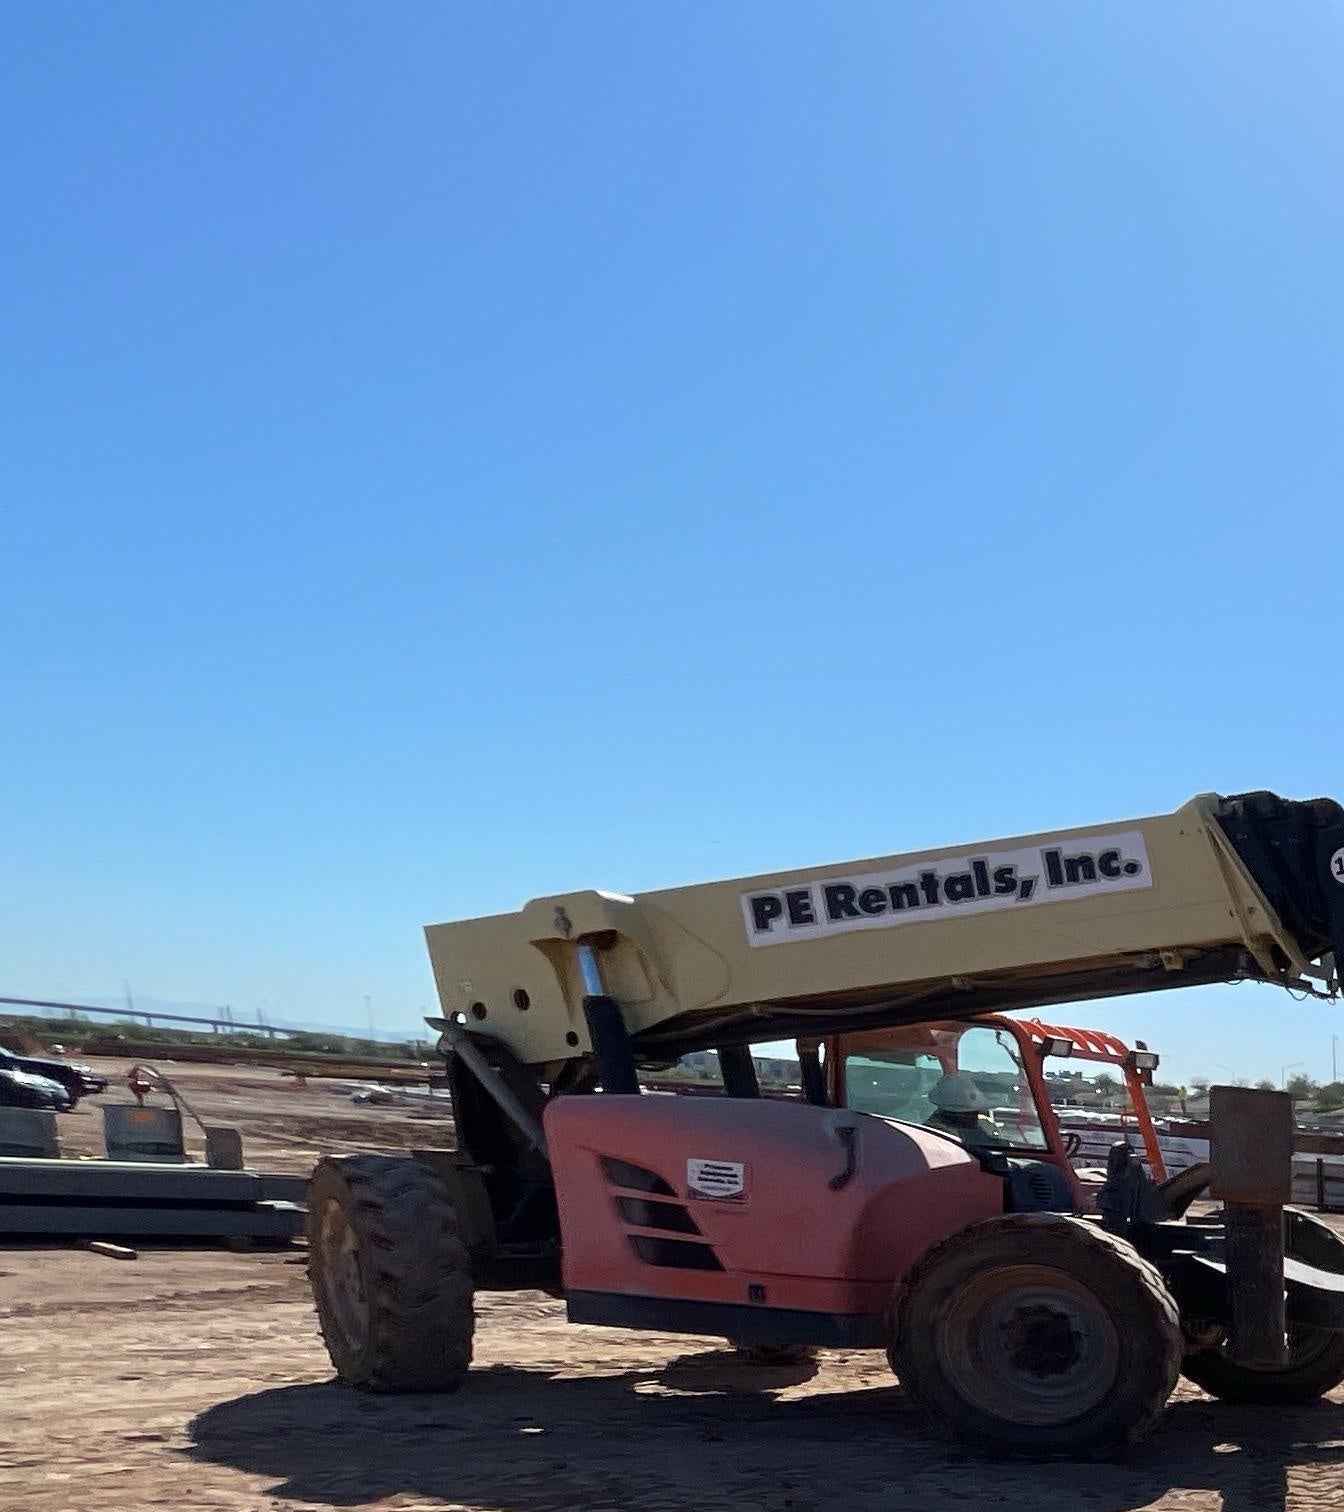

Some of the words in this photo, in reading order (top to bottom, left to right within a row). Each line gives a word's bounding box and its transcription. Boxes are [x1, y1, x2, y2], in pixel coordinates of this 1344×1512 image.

[751, 888, 815, 930] PE
[824, 860, 1036, 921] Rentals,
[1044, 850, 1140, 886] Inc.
